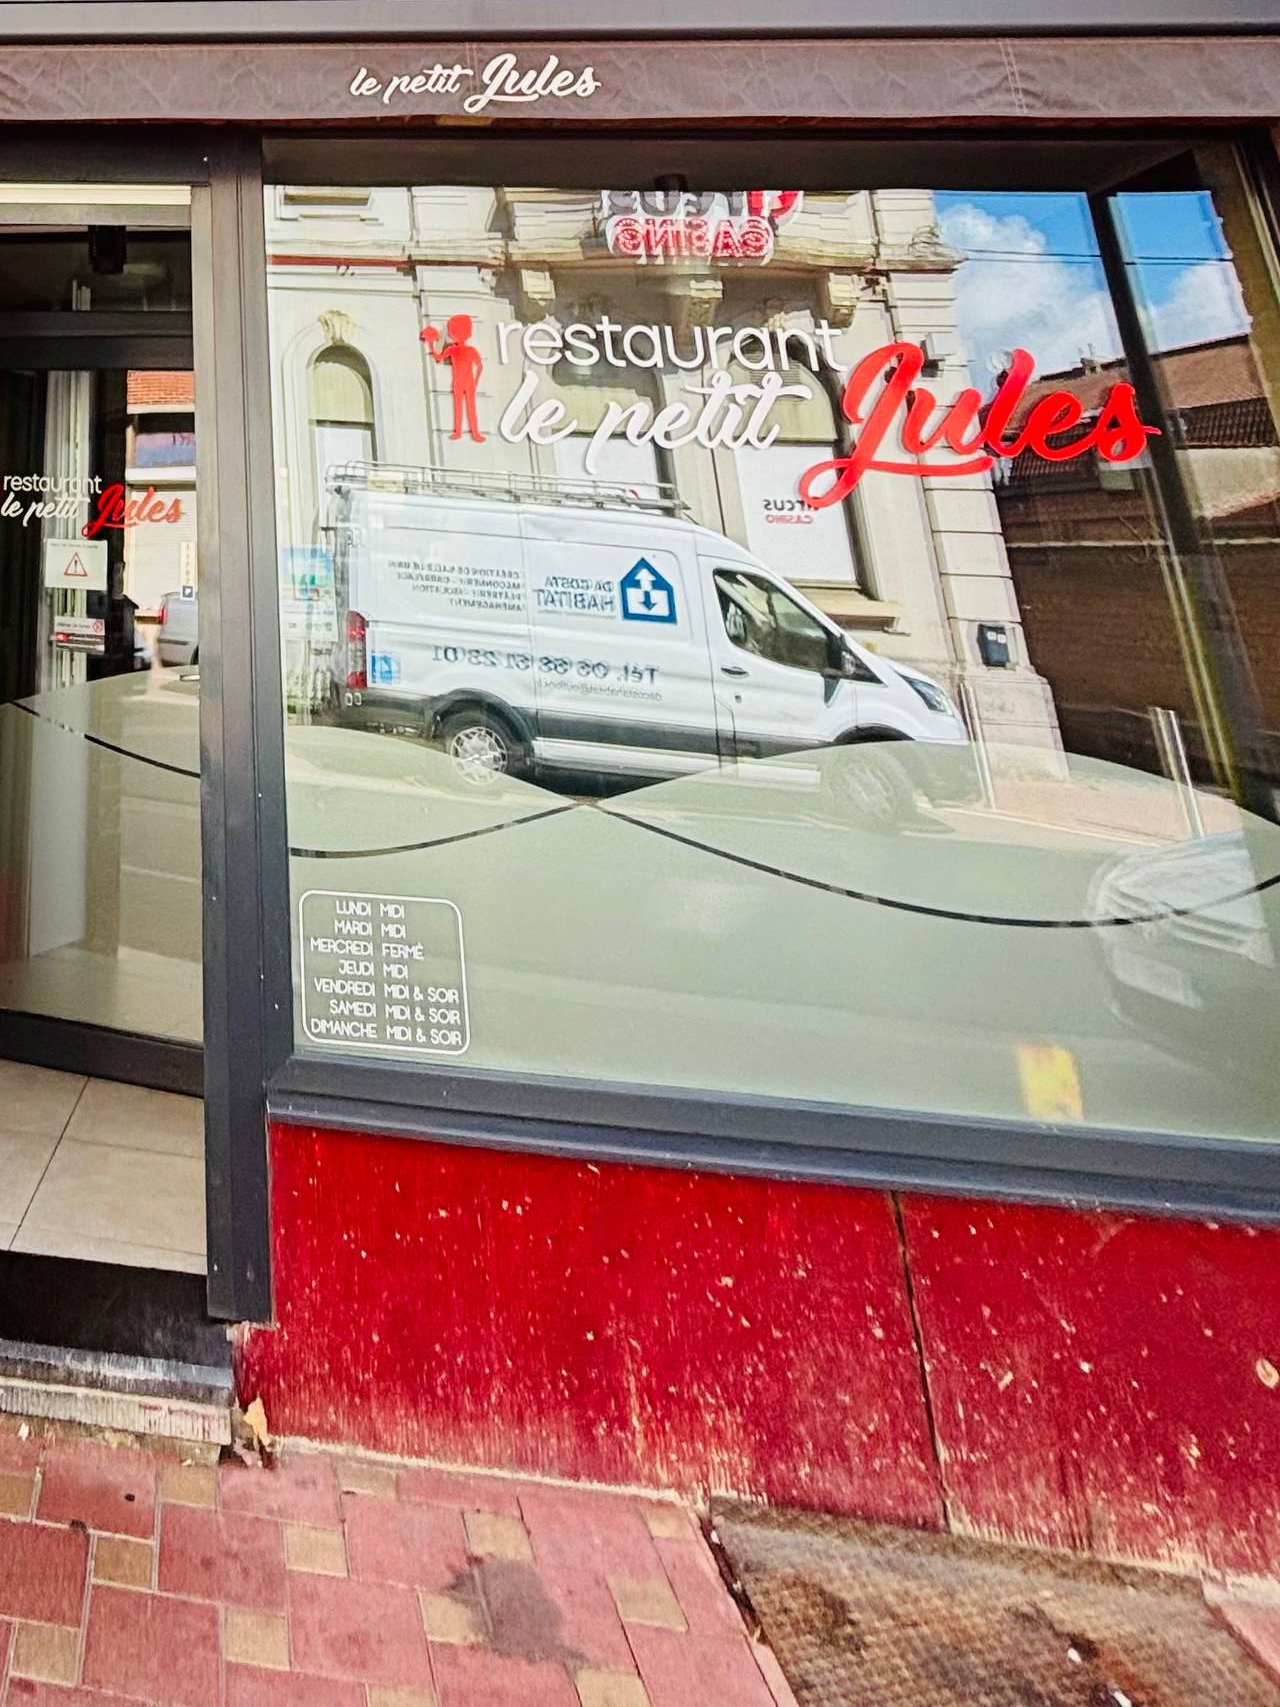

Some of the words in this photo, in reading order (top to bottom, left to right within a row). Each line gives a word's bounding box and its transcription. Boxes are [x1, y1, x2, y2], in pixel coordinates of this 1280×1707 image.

[350, 67, 382, 96] le
[383, 63, 474, 104] petit
[463, 53, 602, 114] Jules
[497, 315, 849, 372] restaurant
[500, 372, 580, 444] le
[585, 371, 813, 475] petit
[798, 341, 1162, 509] Jules
[3, 473, 102, 494] restaurant
[0, 491, 24, 518] le
[23, 494, 91, 527] petit
[81, 483, 186, 538] Jules
[336, 900, 371, 916] LUNDI
[380, 903, 405, 919] MIDI
[334, 920, 372, 936] MARDI
[381, 923, 406, 939] MIDI
[310, 936, 373, 957] MERCREDI
[382, 943, 424, 960] FERMÉ
[338, 959, 375, 976] JEUDI
[383, 963, 408, 979] MIDI
[314, 977, 376, 997] VENDREDI
[384, 983, 409, 1000] MIDI
[413, 986, 423, 1000] &
[427, 987, 460, 1004] SOIR
[330, 999, 376, 1017] SAMEDI
[385, 1004, 410, 1020] MIDI
[415, 1007, 425, 1022] &
[429, 1008, 461, 1025] SOIR
[311, 1018, 378, 1039] DIMANCHE
[386, 1025, 412, 1041] MIDI
[416, 1027, 426, 1043] &
[430, 1029, 462, 1046] SOIR
